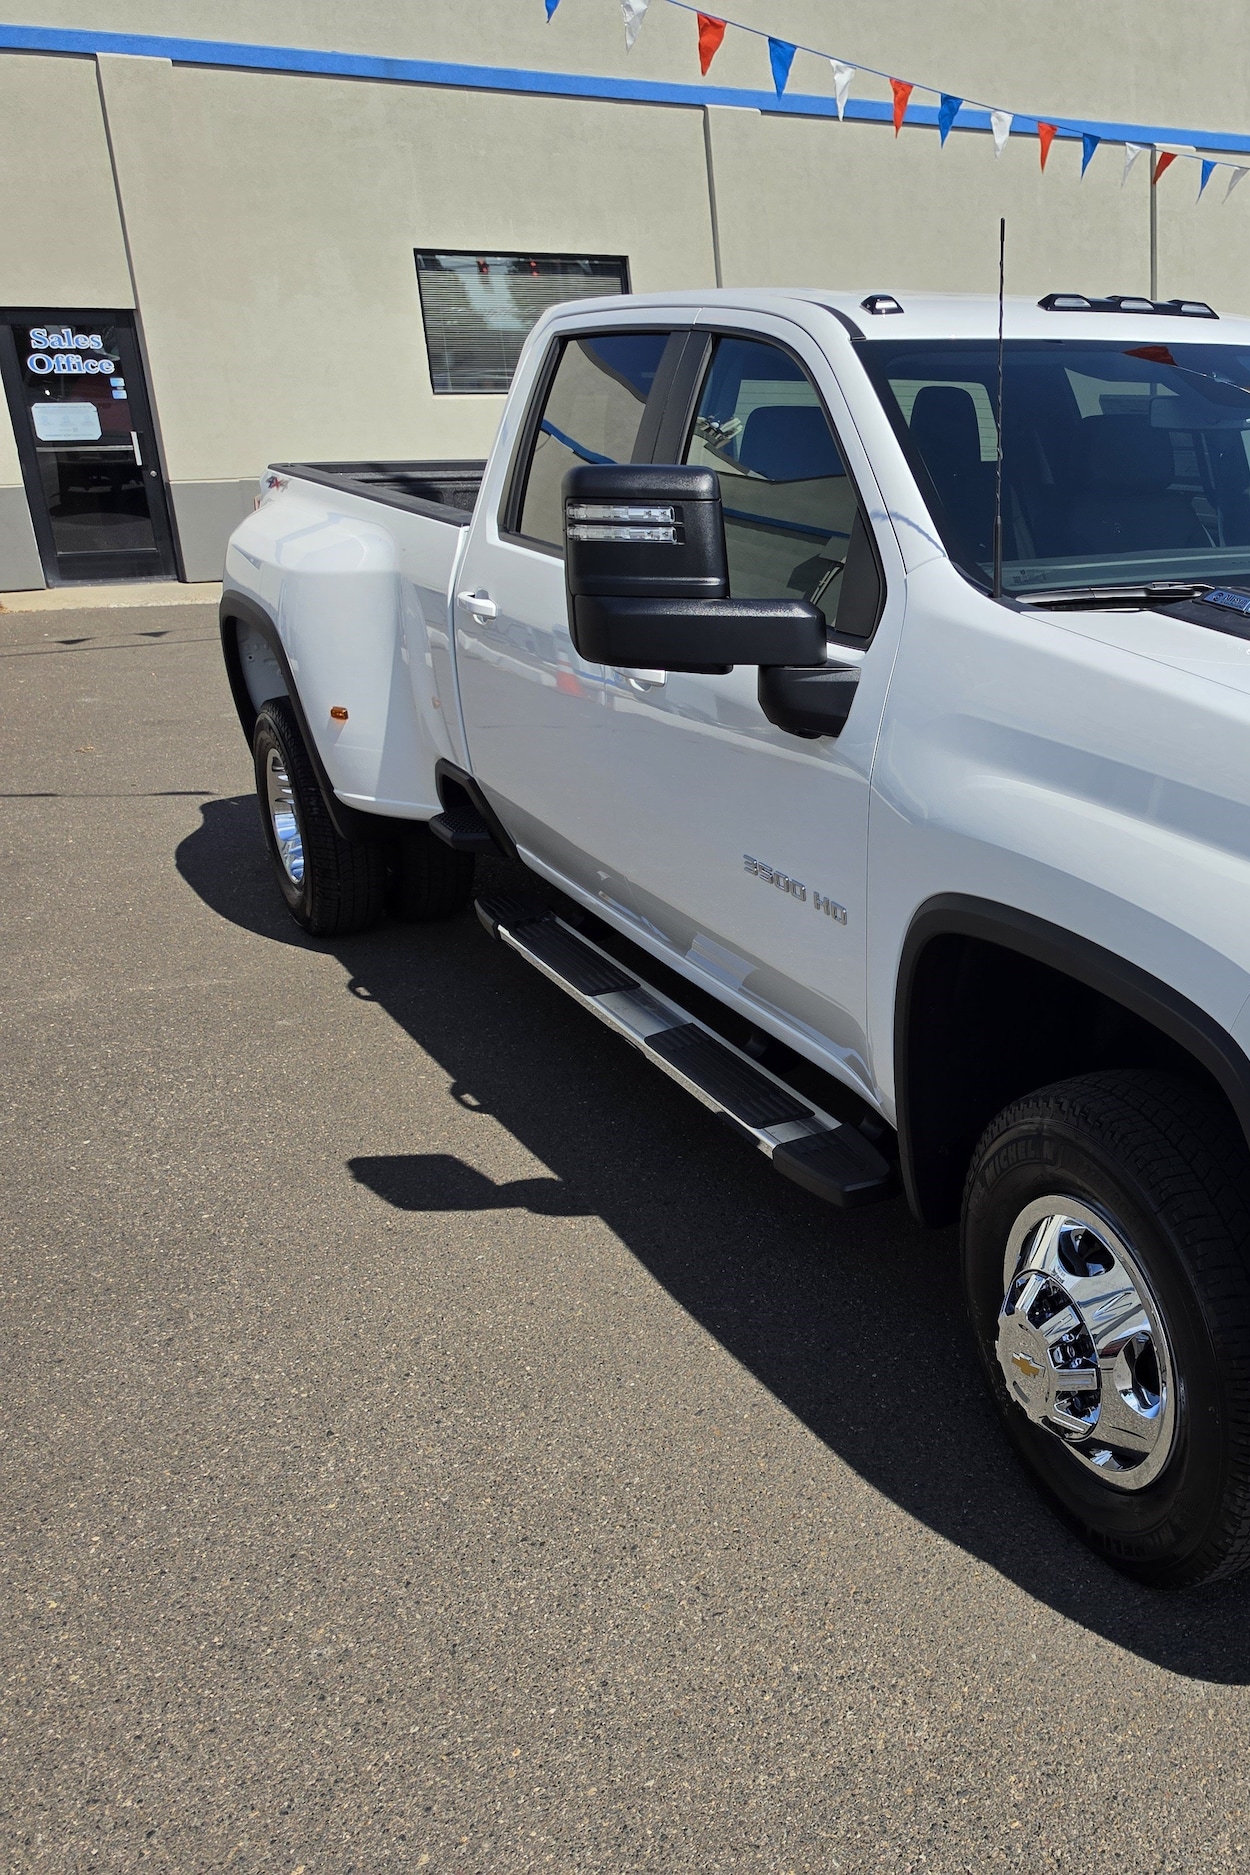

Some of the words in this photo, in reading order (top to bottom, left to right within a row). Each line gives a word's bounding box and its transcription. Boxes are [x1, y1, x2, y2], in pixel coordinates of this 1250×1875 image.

[29, 328, 104, 349] Sales
[27, 353, 115, 374] Office
[743, 854, 806, 902] 3500
[813, 891, 848, 926] HD
